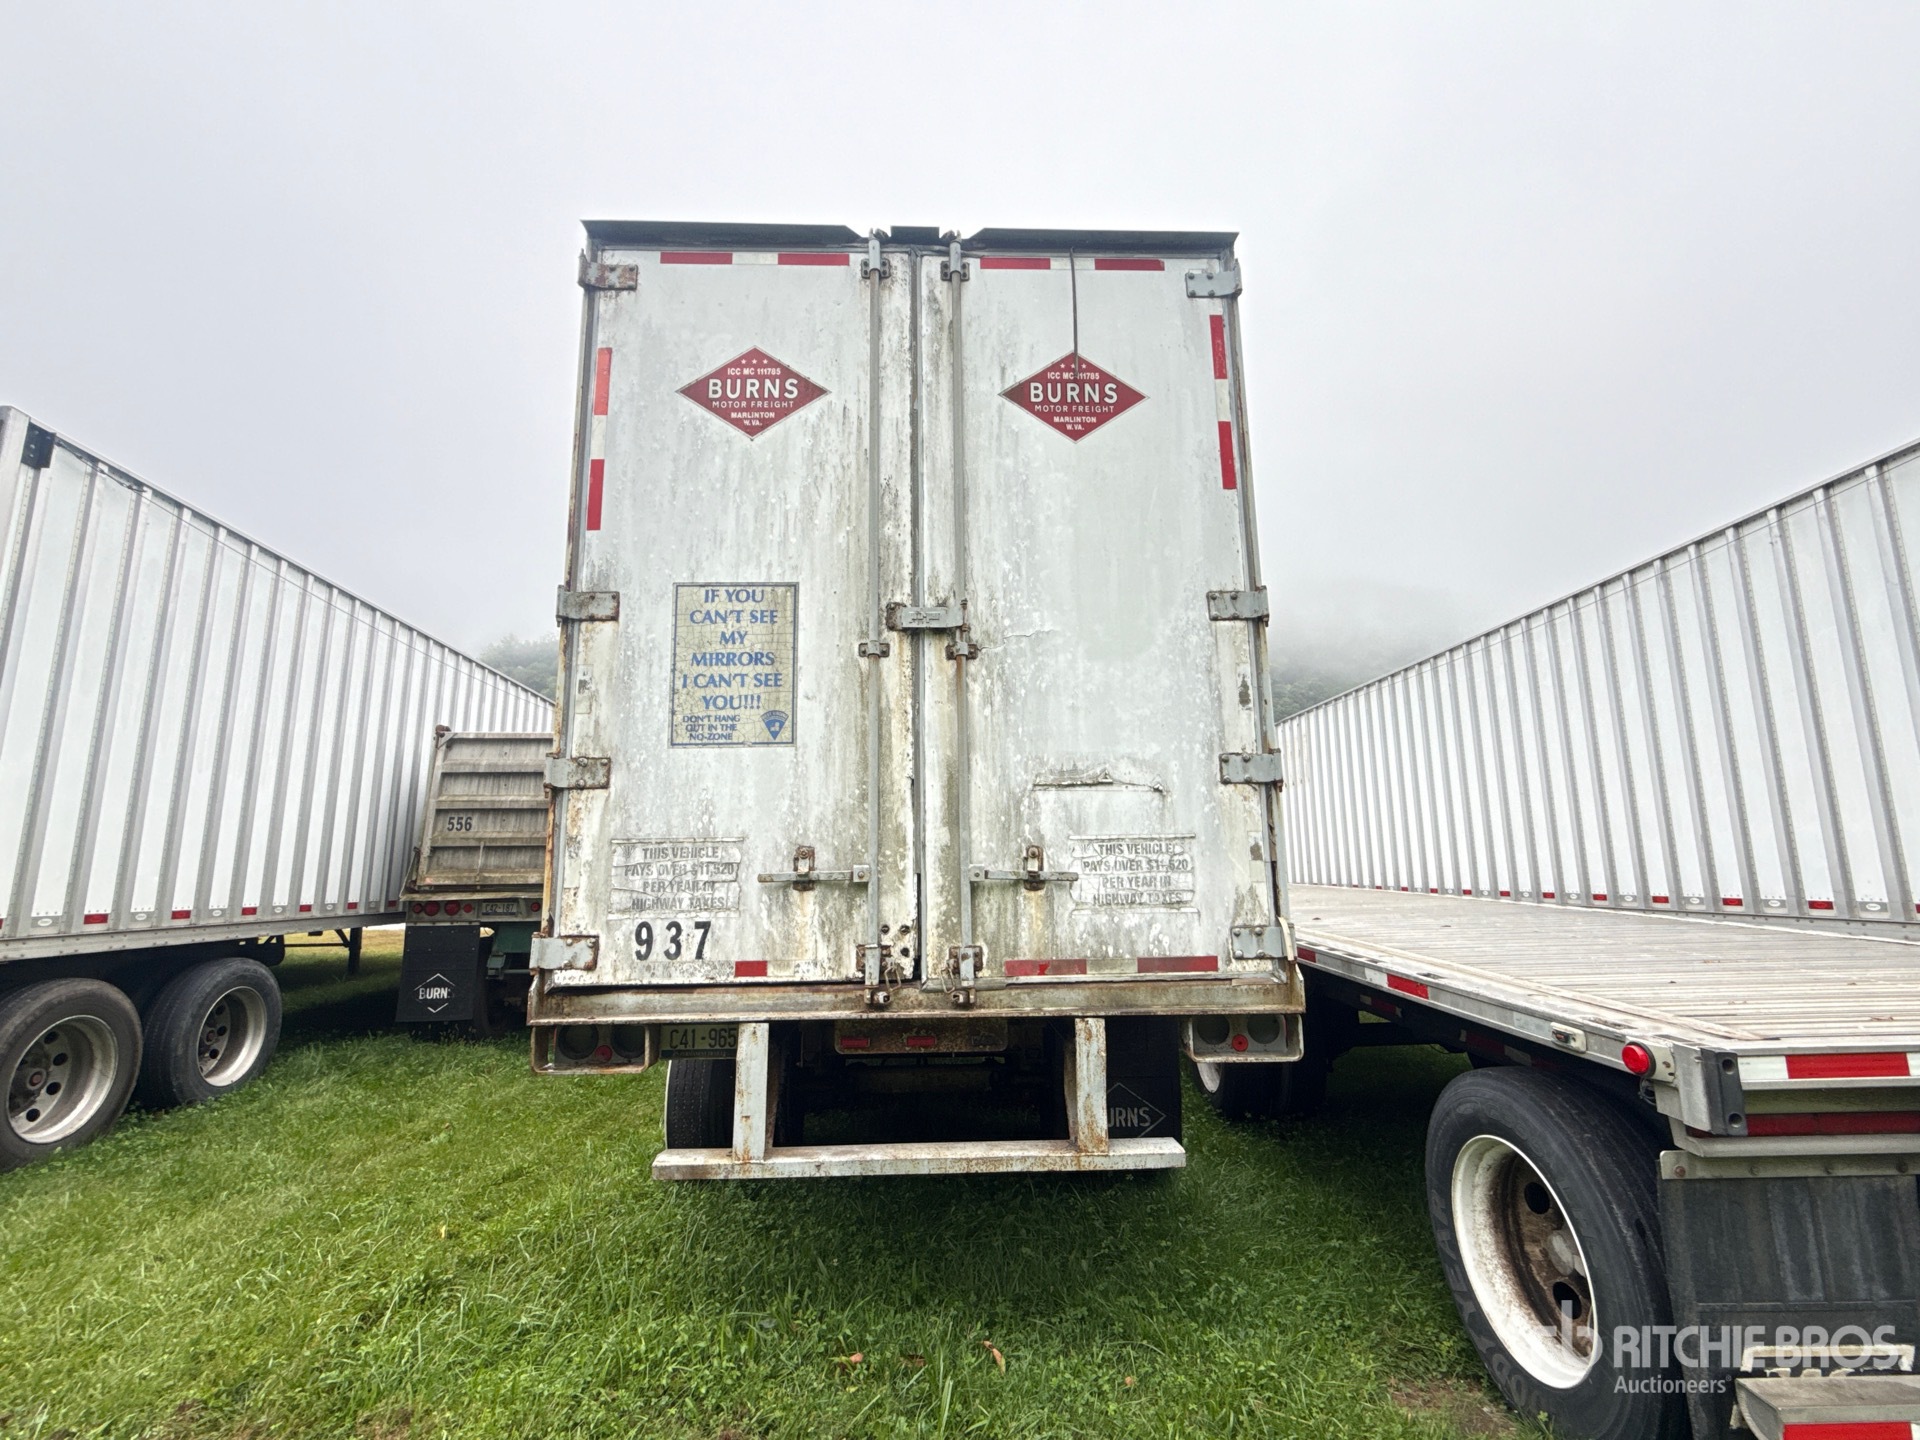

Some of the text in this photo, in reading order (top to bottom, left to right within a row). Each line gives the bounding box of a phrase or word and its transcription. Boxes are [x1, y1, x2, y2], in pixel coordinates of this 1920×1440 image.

[727, 368, 781, 376] ICC MC 111785
[1047, 372, 1061, 380] ICC
[1062, 372, 1074, 380] MC
[708, 378, 799, 399] BURNS
[1029, 382, 1118, 404] BURNS
[712, 401, 794, 409] MOTOR FREIGHT
[1035, 405, 1115, 413] MOTOR FREIGHT
[704, 589, 765, 603] IF YOU
[689, 609, 778, 624] CAN'T SEE
[719, 631, 748, 645] MY
[690, 652, 775, 667] MIRRORS
[682, 673, 783, 689] I CAN'T SEE
[702, 695, 761, 710] YOU!!!
[682, 715, 741, 723] DON'T HANG
[685, 723, 738, 732] OUT IN THE
[689, 733, 733, 741] NO-ZONE
[447, 816, 473, 832] 556
[643, 846, 719, 859] THIS VEHICLE
[1098, 843, 1172, 855] THIS VEHICLE
[624, 864, 654, 876] PAYS
[658, 863, 687, 876] OVER
[1083, 860, 1111, 872] PAYS
[1114, 859, 1143, 871] OVER
[643, 880, 715, 893] PER YEAR IN
[1102, 875, 1171, 888] PER YEAR IN
[632, 897, 725, 910] HIGHWAY TAXES
[1093, 892, 1144, 905] HIGHWAY
[635, 920, 711, 961] 937
[418, 987, 451, 999] BURN
[669, 1028, 737, 1049] C41-965
[1107, 1107, 1152, 1128] URNS
